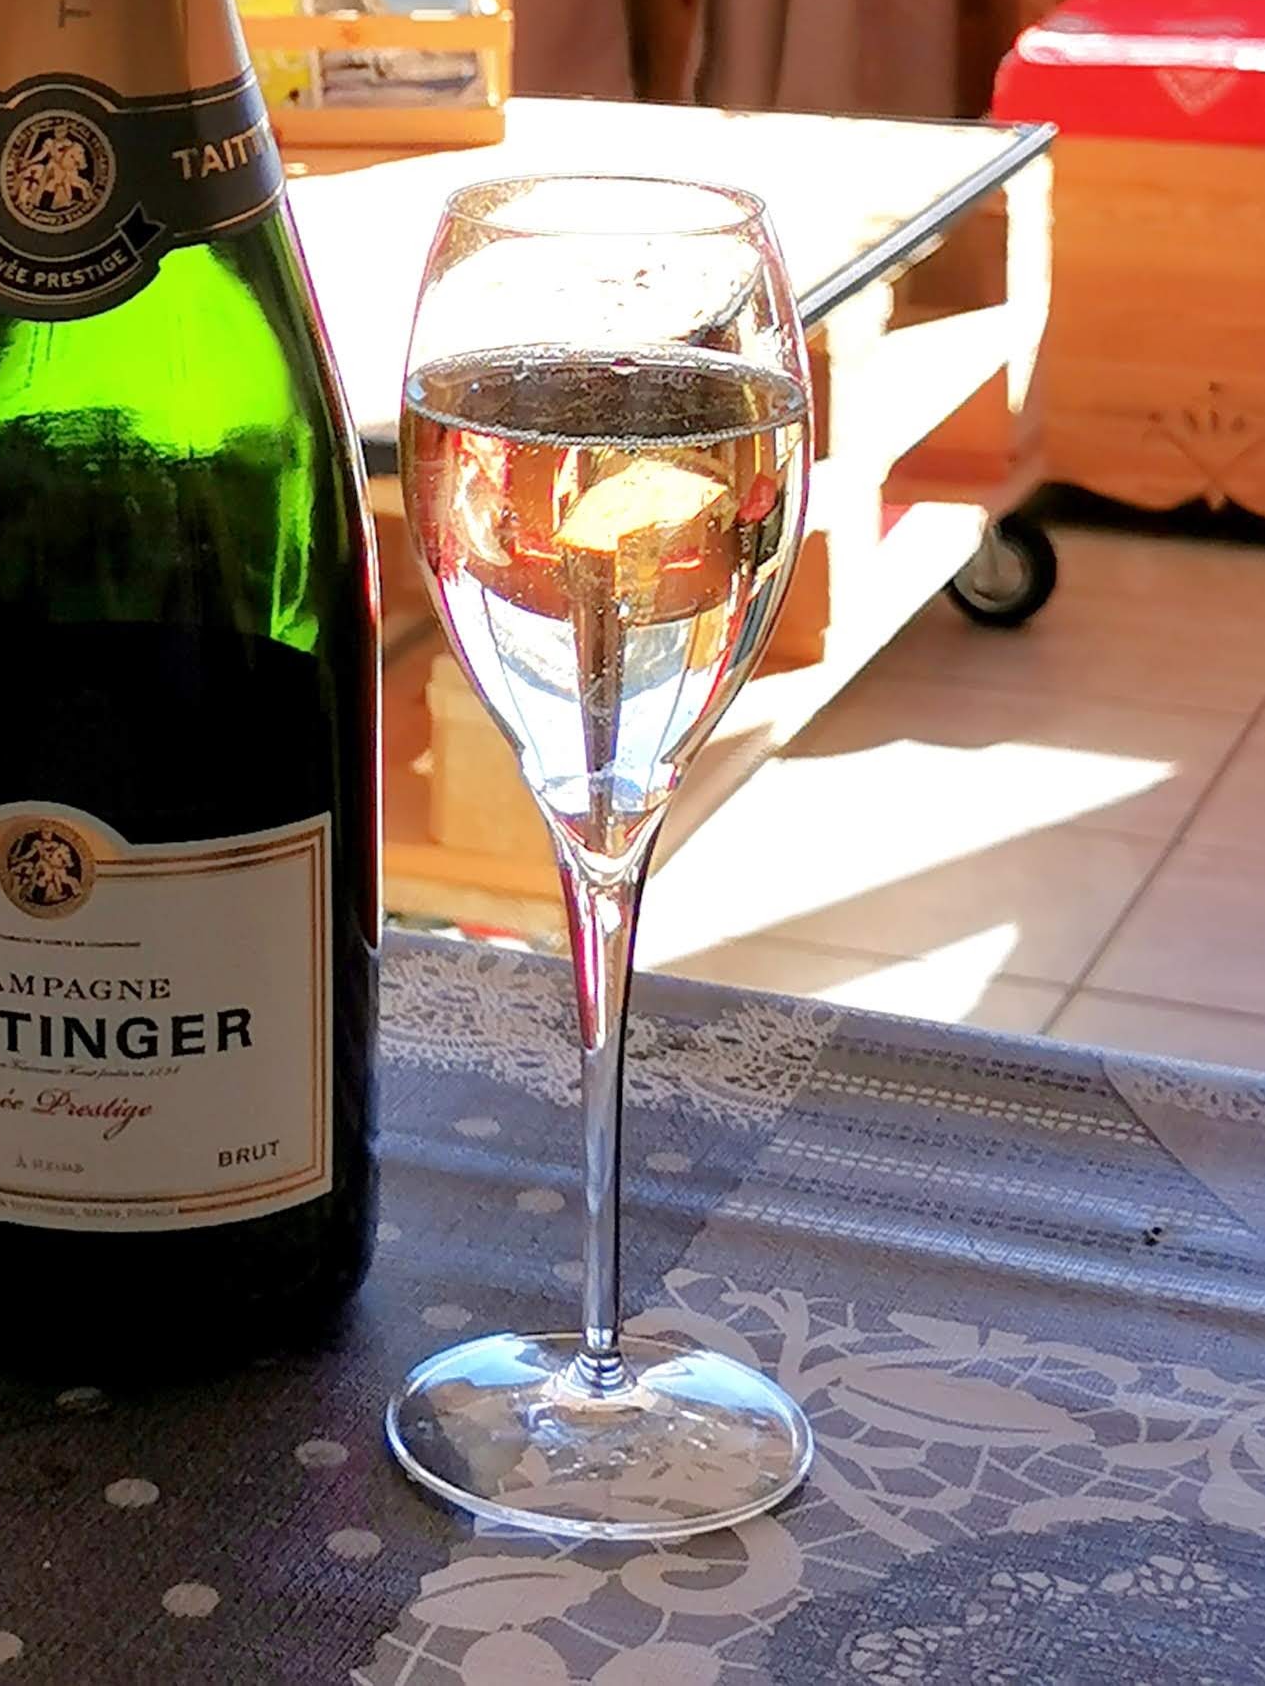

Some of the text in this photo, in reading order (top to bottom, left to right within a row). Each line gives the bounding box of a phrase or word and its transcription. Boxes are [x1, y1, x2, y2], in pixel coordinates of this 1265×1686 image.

[33, 248, 129, 288] PRESTIGE
[30, 1087, 154, 1141] Prestige
[218, 1140, 281, 1168] BRUT
